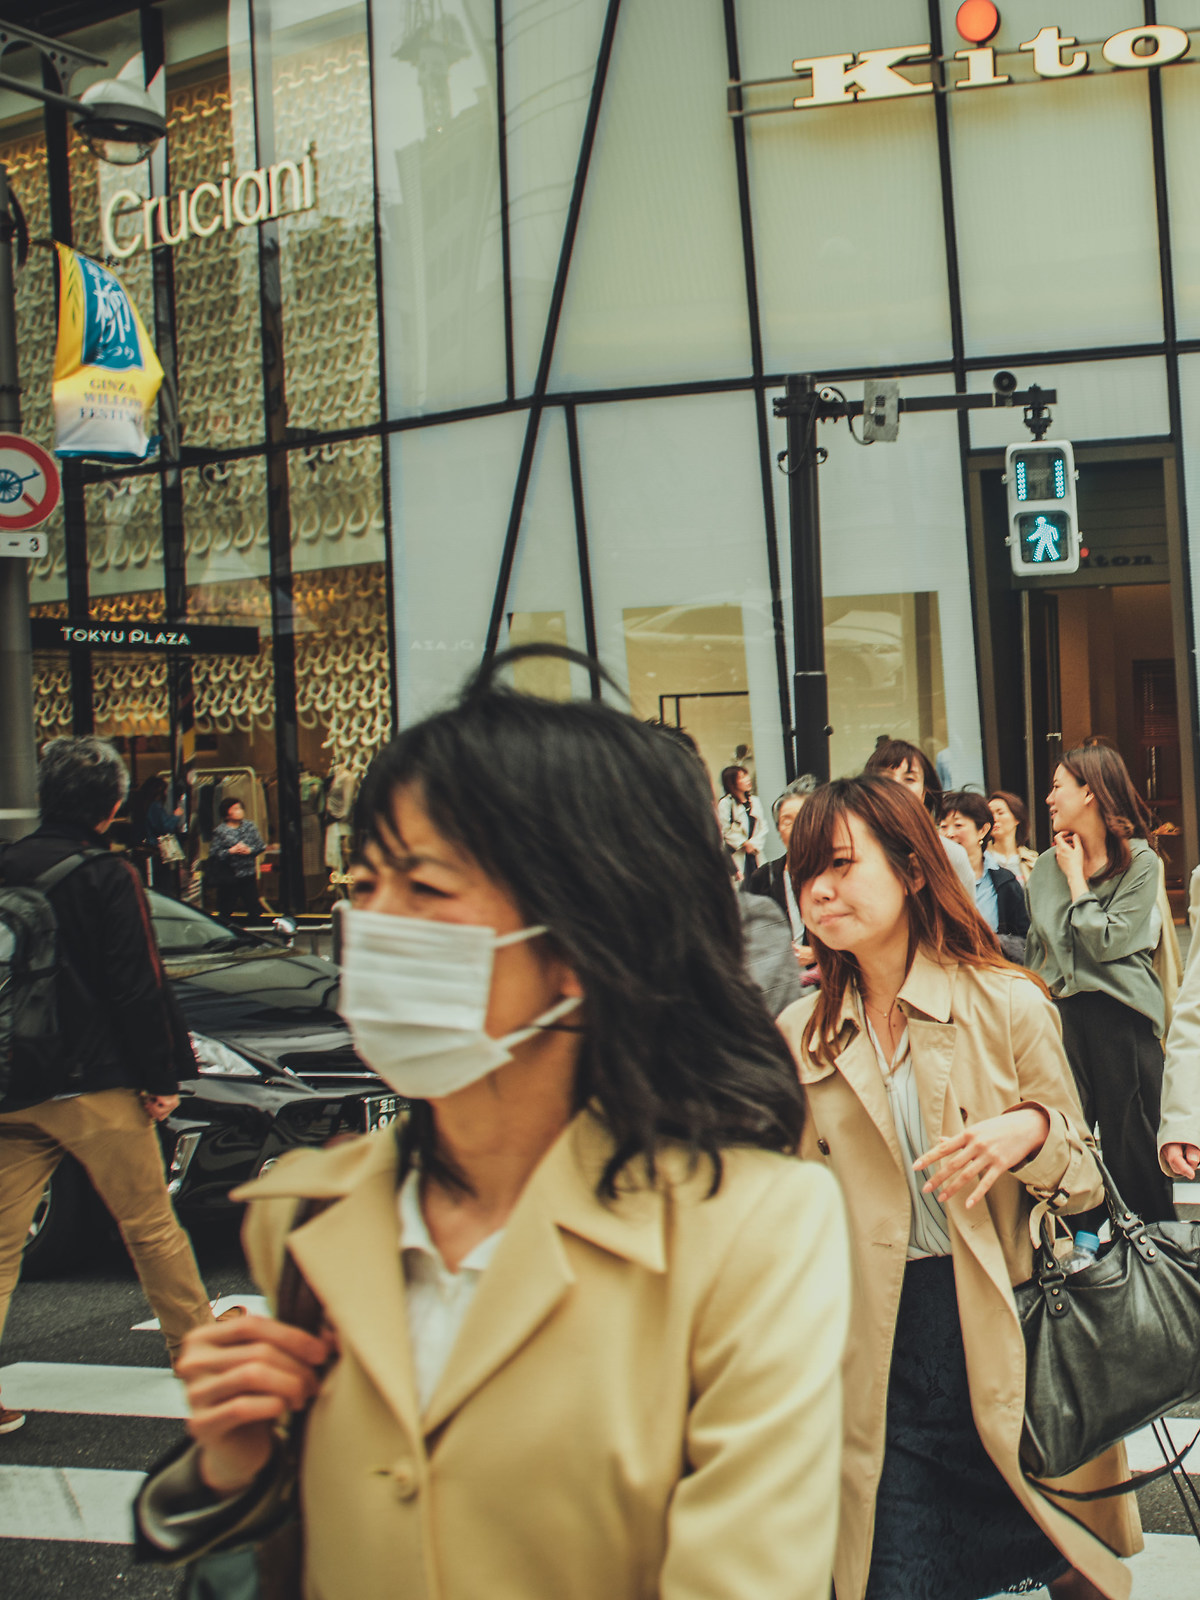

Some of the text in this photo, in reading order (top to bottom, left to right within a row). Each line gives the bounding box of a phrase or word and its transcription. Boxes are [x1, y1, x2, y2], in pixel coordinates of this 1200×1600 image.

[103, 138, 315, 258] Cruciani
[89, 378, 137, 396] GINZA
[80, 406, 143, 426] FESTIV
[1080, 547, 1153, 568] iton
[60, 626, 191, 645] TOKYU PLAZA
